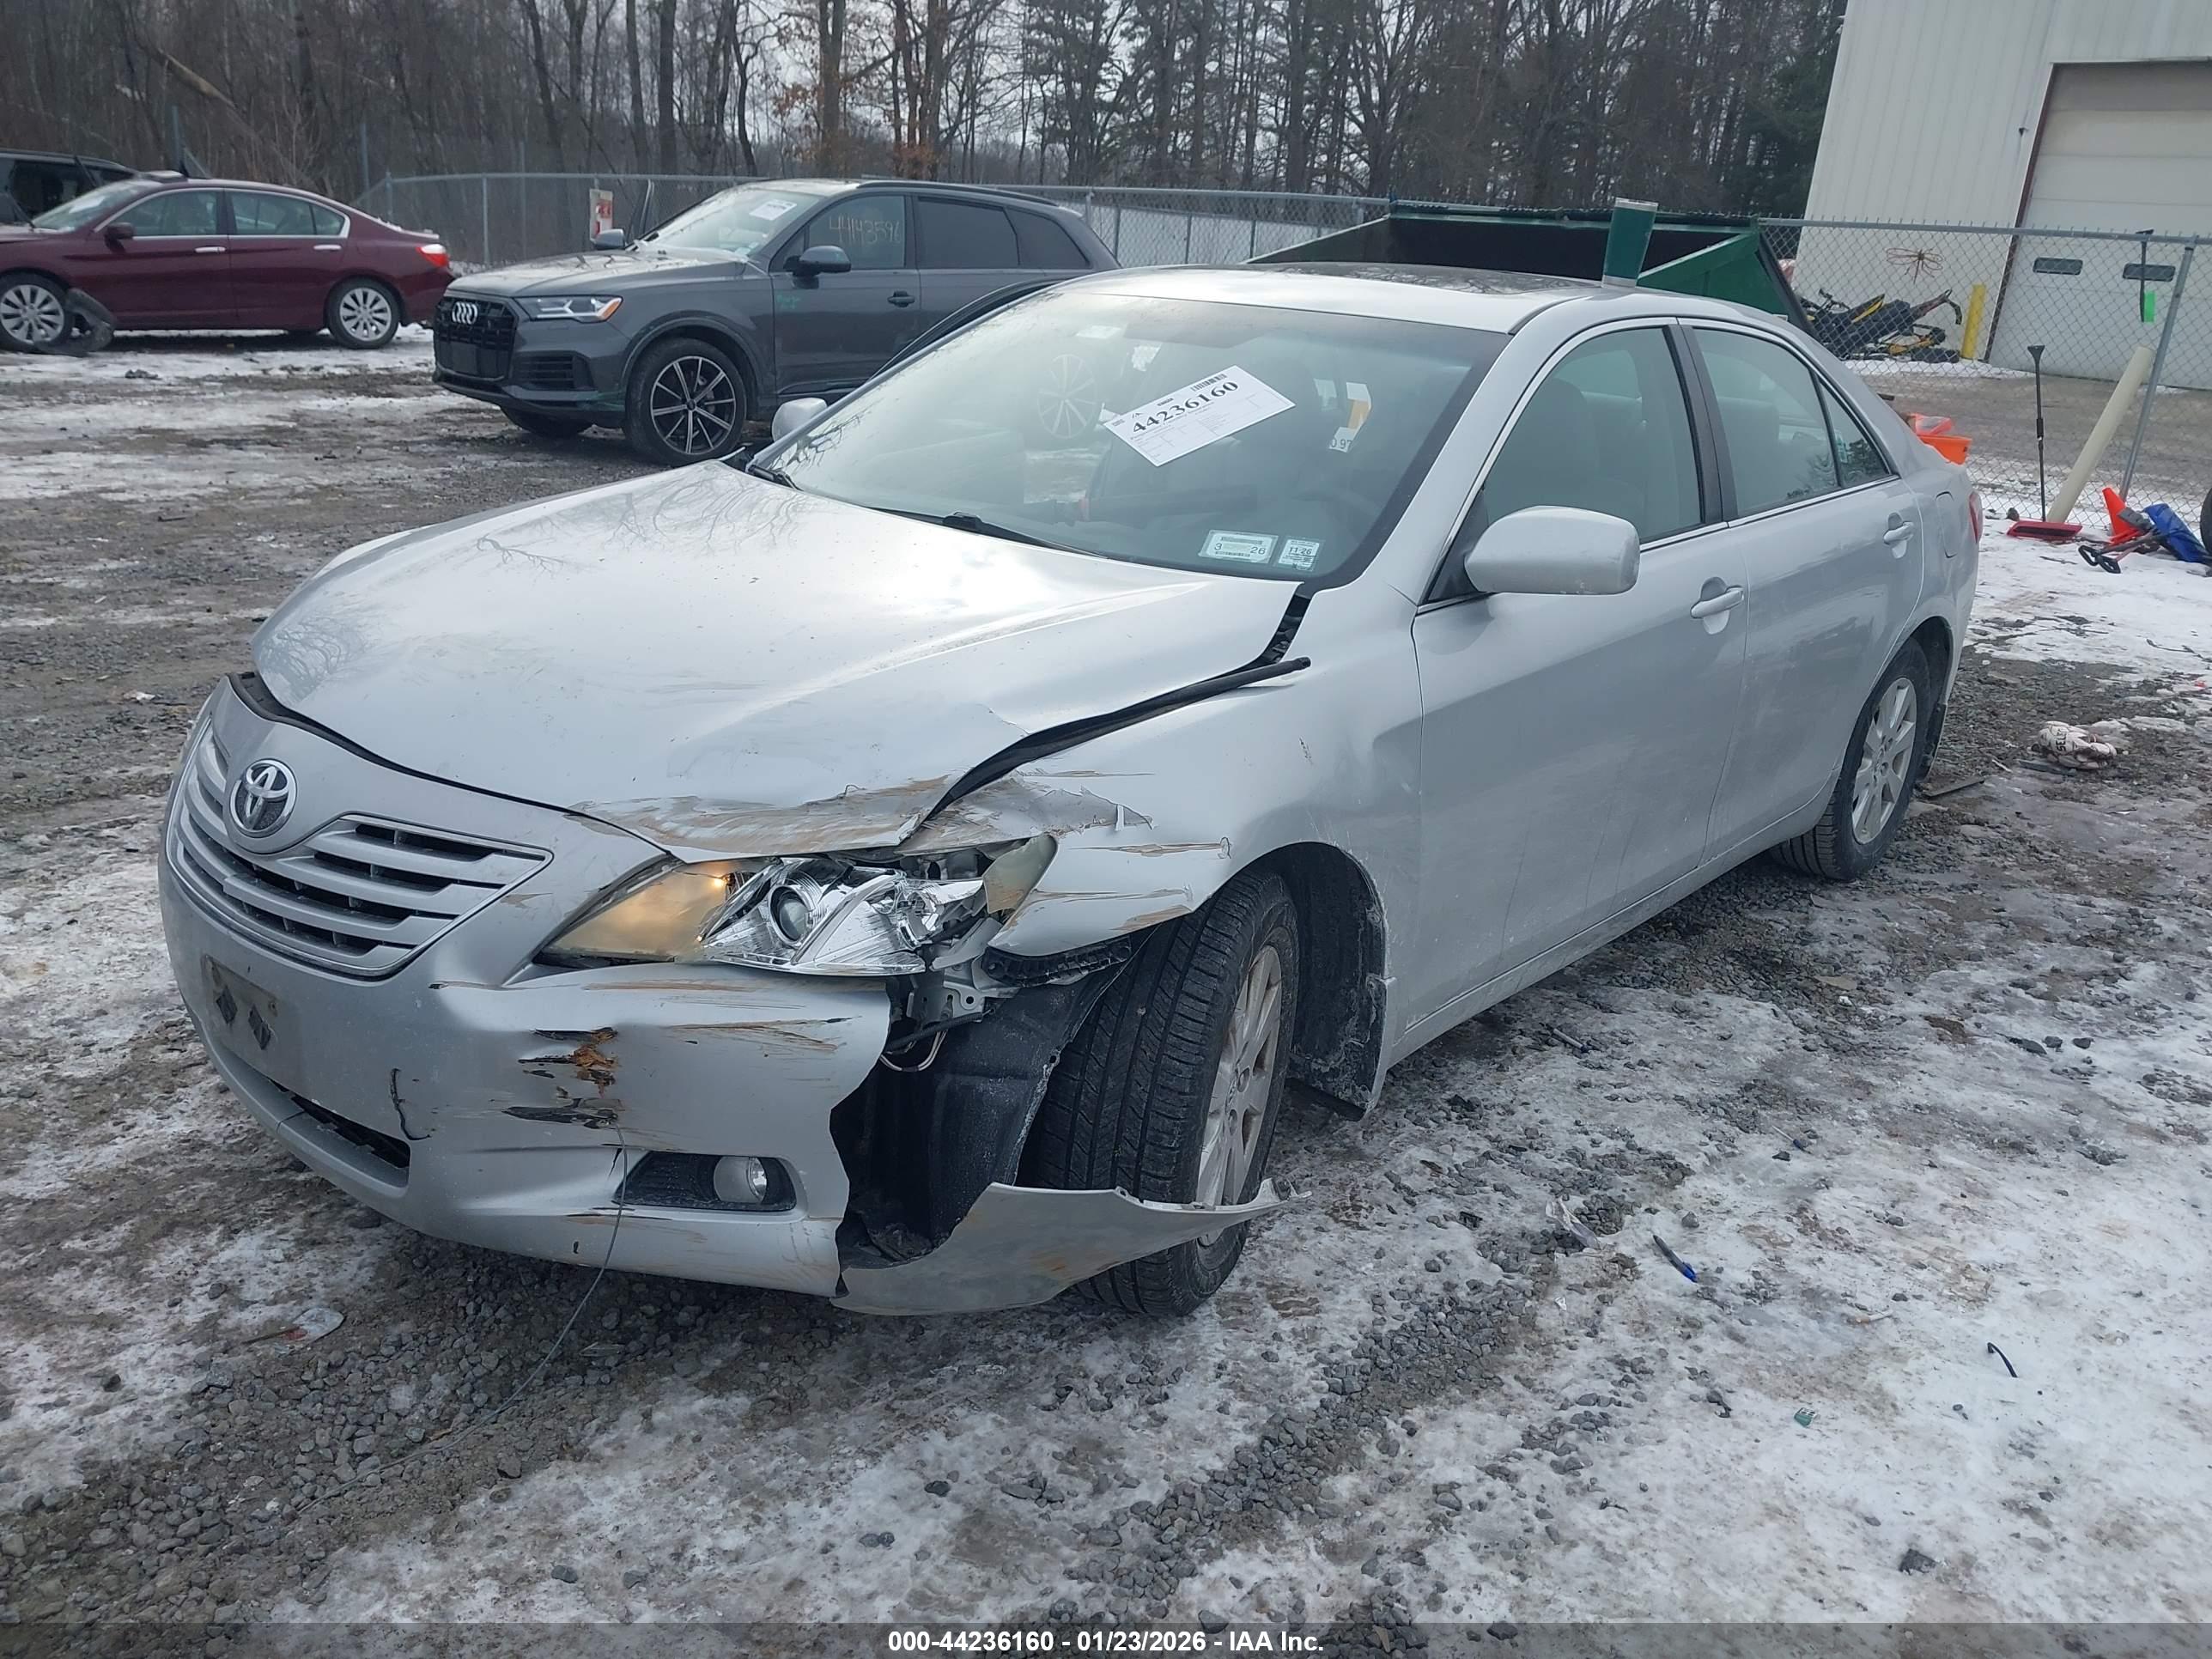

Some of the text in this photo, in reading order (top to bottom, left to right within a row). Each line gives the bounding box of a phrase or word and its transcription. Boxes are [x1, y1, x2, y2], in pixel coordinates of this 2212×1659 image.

[1132, 380, 1239, 434] 44236160
[1213, 542, 1223, 551] 3
[1249, 546, 1267, 556] 26
